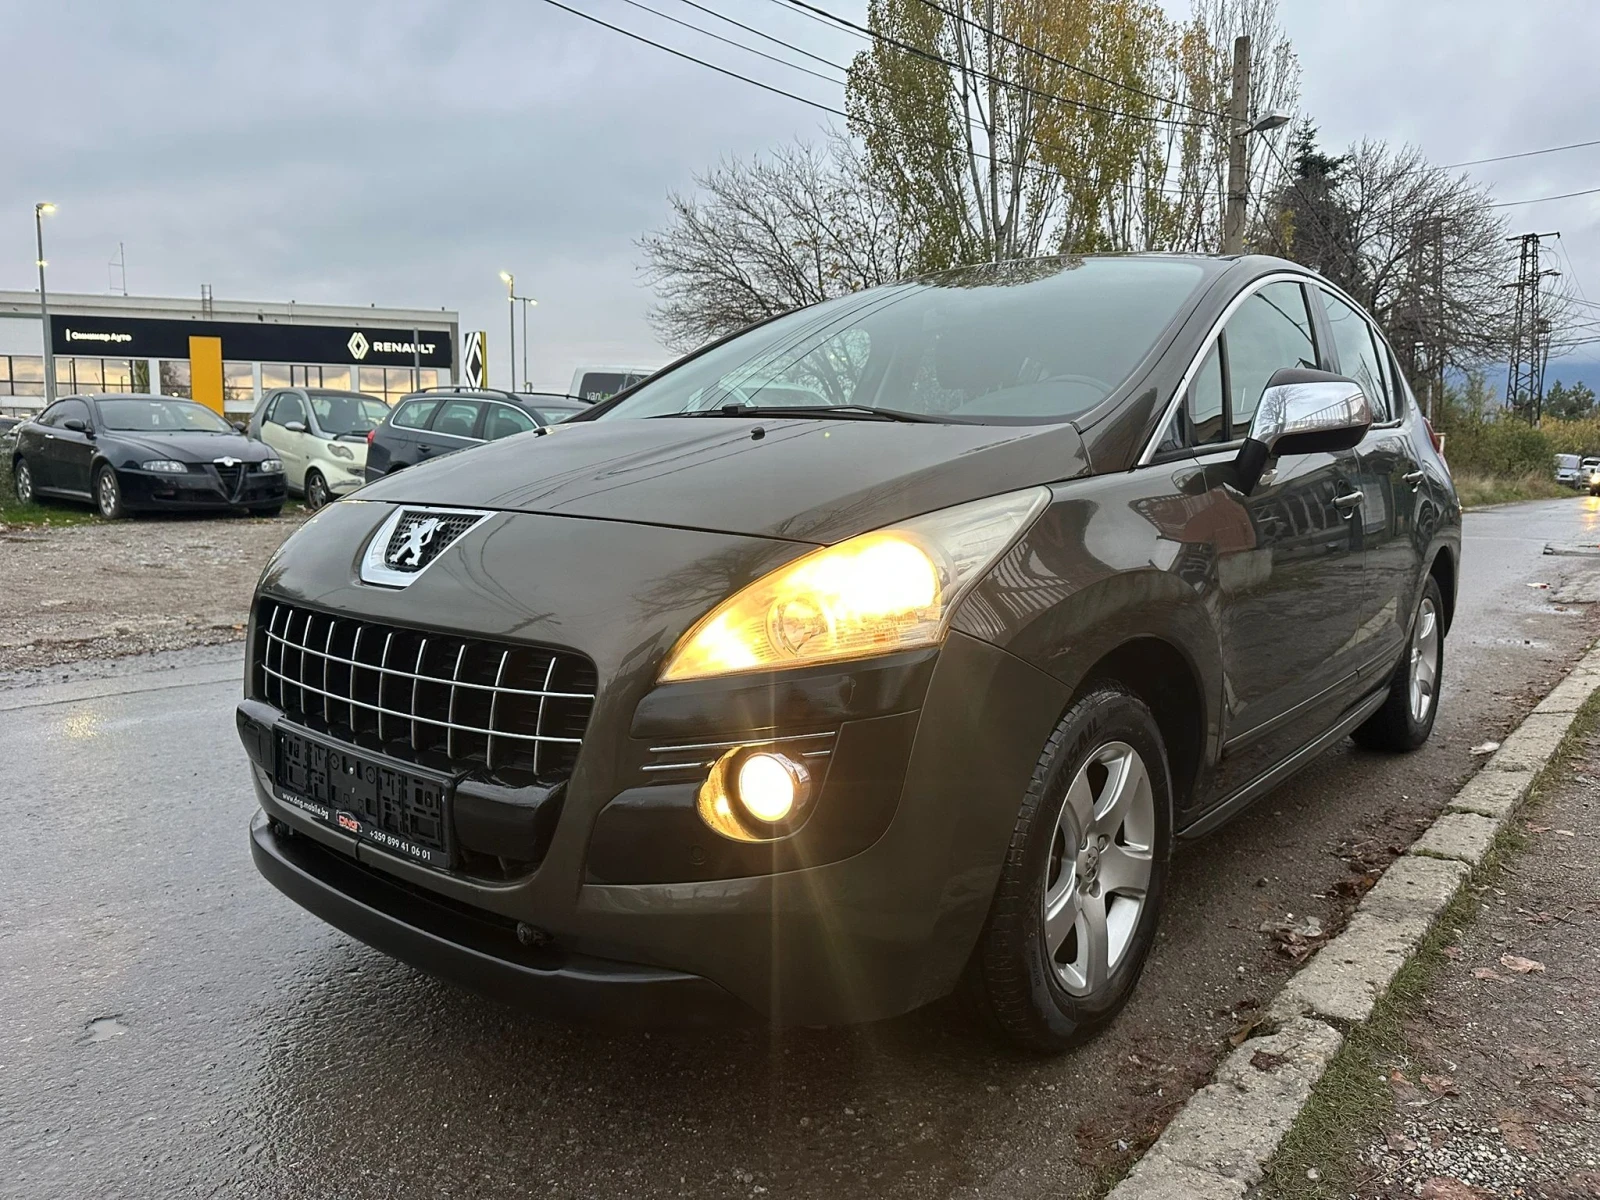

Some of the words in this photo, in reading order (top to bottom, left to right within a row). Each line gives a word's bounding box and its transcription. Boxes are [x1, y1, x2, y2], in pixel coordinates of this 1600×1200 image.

[373, 341, 436, 354] RENAULT
[282, 792, 329, 820] www.dng.mobile.bg
[369, 830, 386, 843] +359
[387, 836, 400, 848] 899
[400, 841, 409, 852] 41
[411, 845, 421, 857] 06
[421, 849, 431, 860] 01
